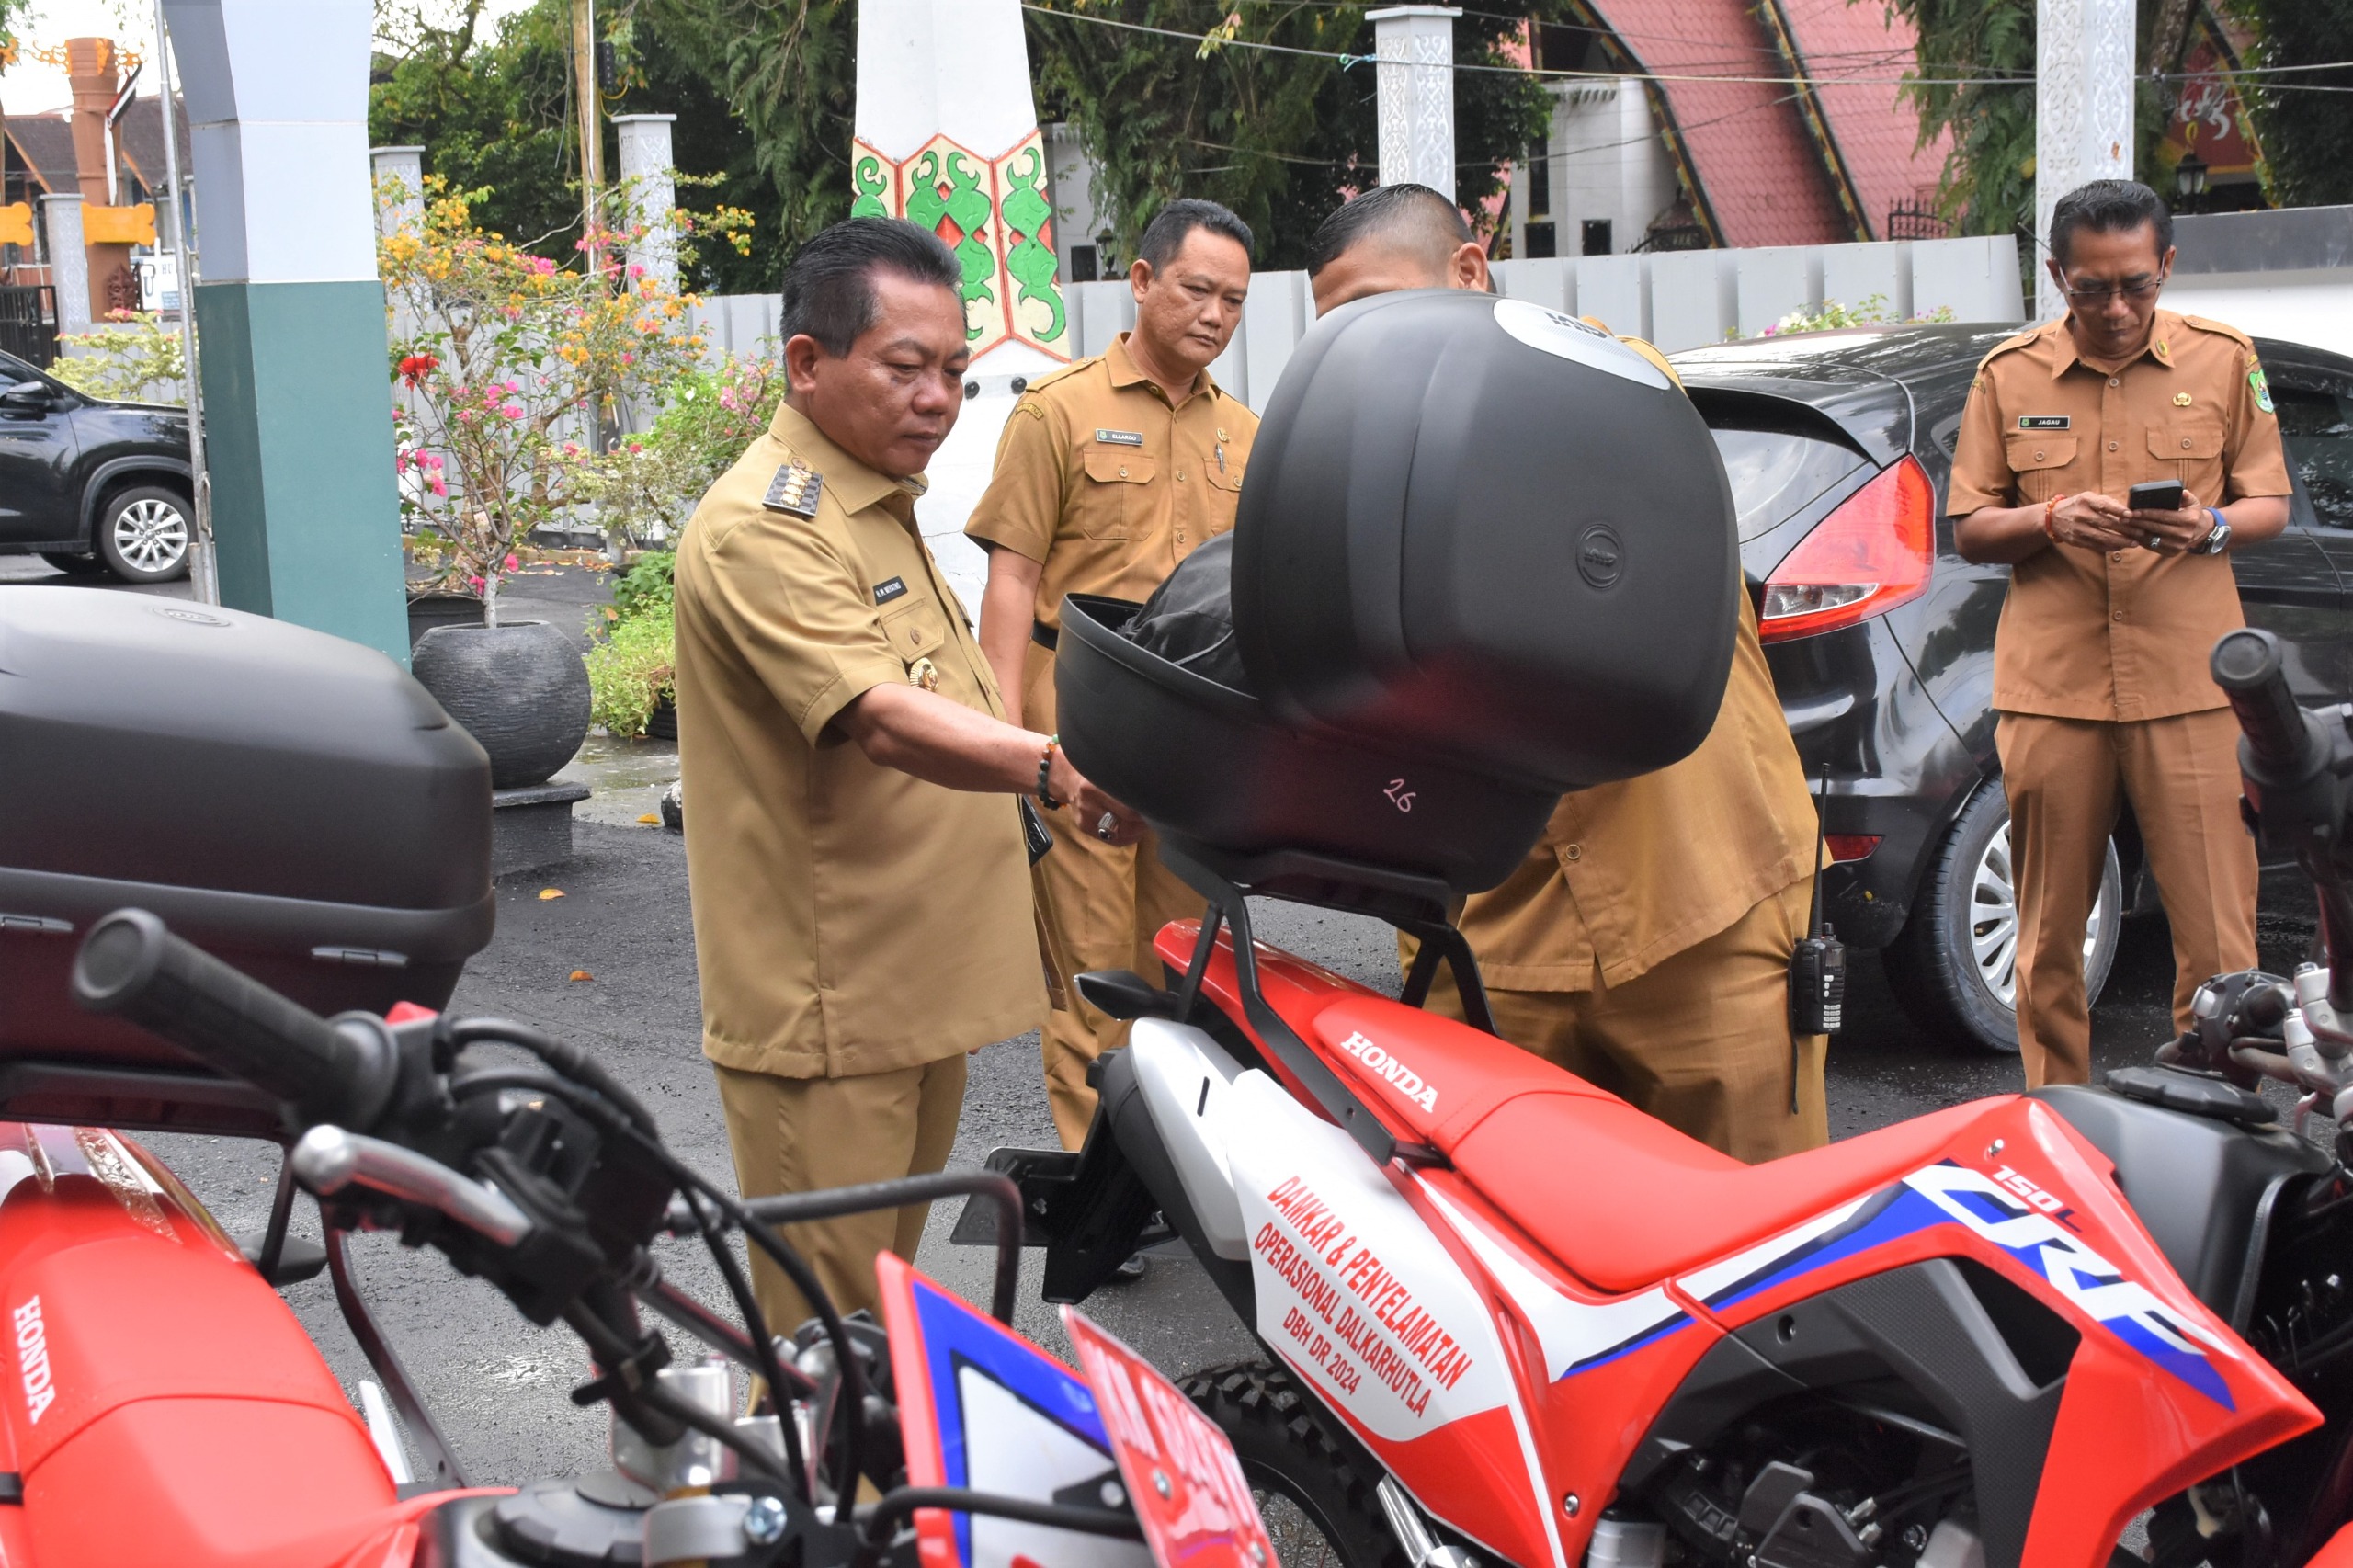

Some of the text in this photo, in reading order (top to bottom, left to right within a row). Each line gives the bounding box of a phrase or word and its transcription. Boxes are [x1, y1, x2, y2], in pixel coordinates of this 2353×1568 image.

[1383, 778, 1416, 812] 26
[1340, 1030, 1438, 1113] HONDA
[1254, 1221, 1432, 1419] OPERASIONAL DALKARHUTLA
[1267, 1175, 1473, 1392] DAMKAR & PENYELAMATAN
[1902, 1165, 2243, 1360] CRF
[14, 1294, 56, 1425] HONDA
[1282, 1306, 1362, 1396] DBH DR 2024
